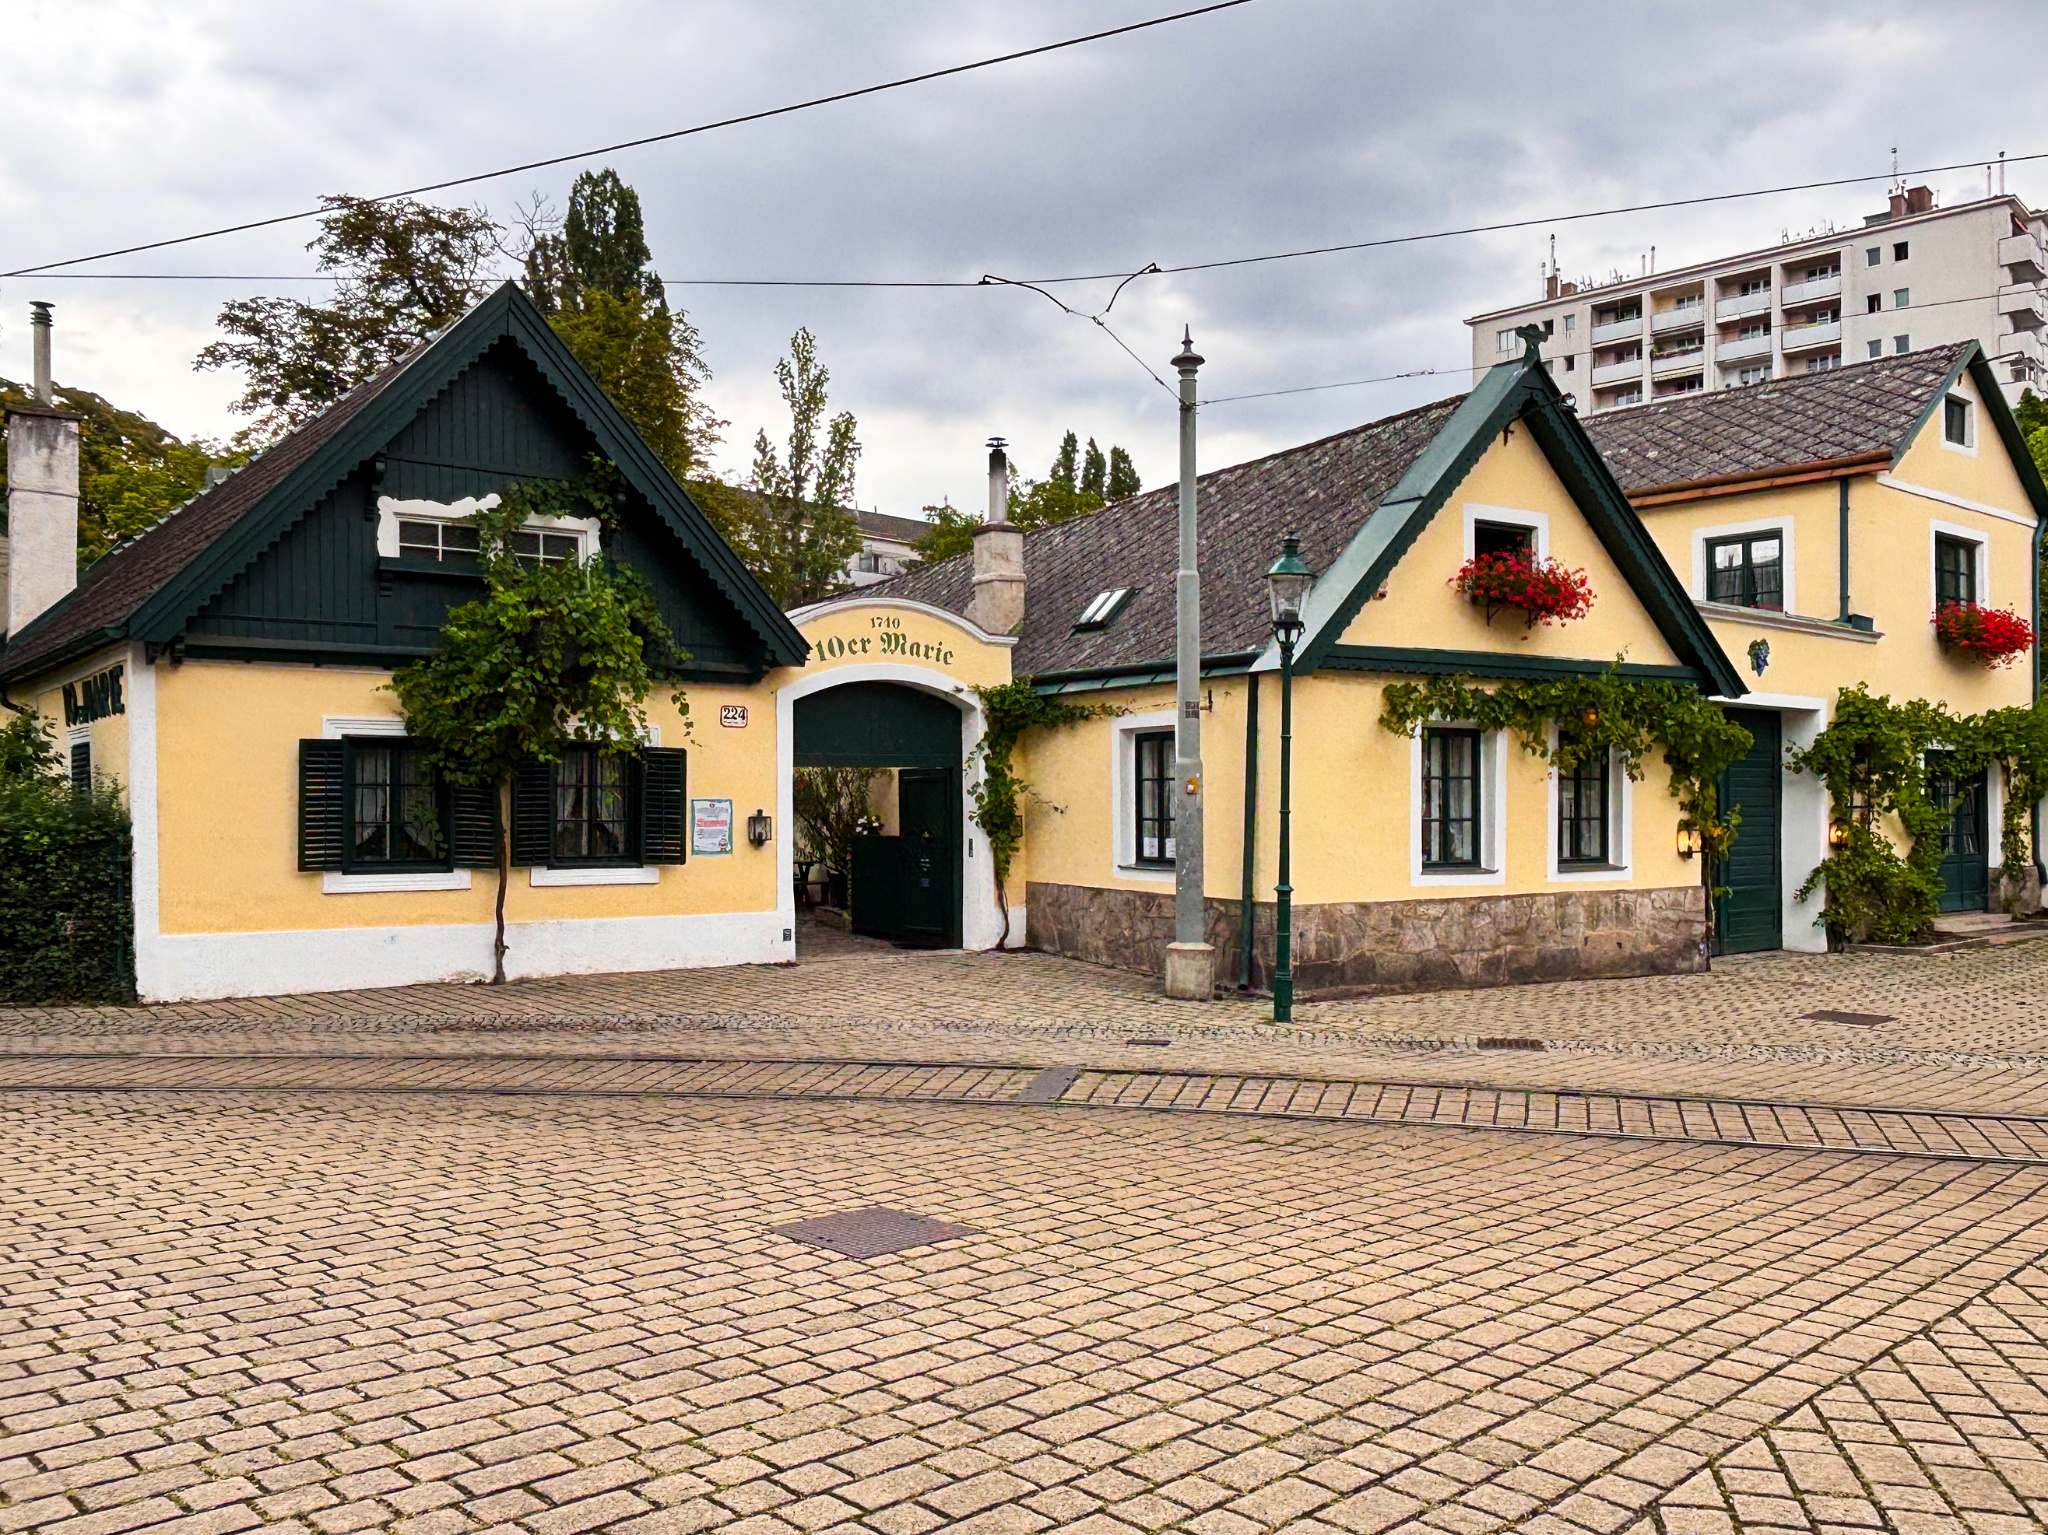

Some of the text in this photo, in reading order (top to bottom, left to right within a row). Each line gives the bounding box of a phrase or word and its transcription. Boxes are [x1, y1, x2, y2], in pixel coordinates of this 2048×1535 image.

[815, 631, 954, 665] 10er Marie
[723, 707, 746, 721] 224
